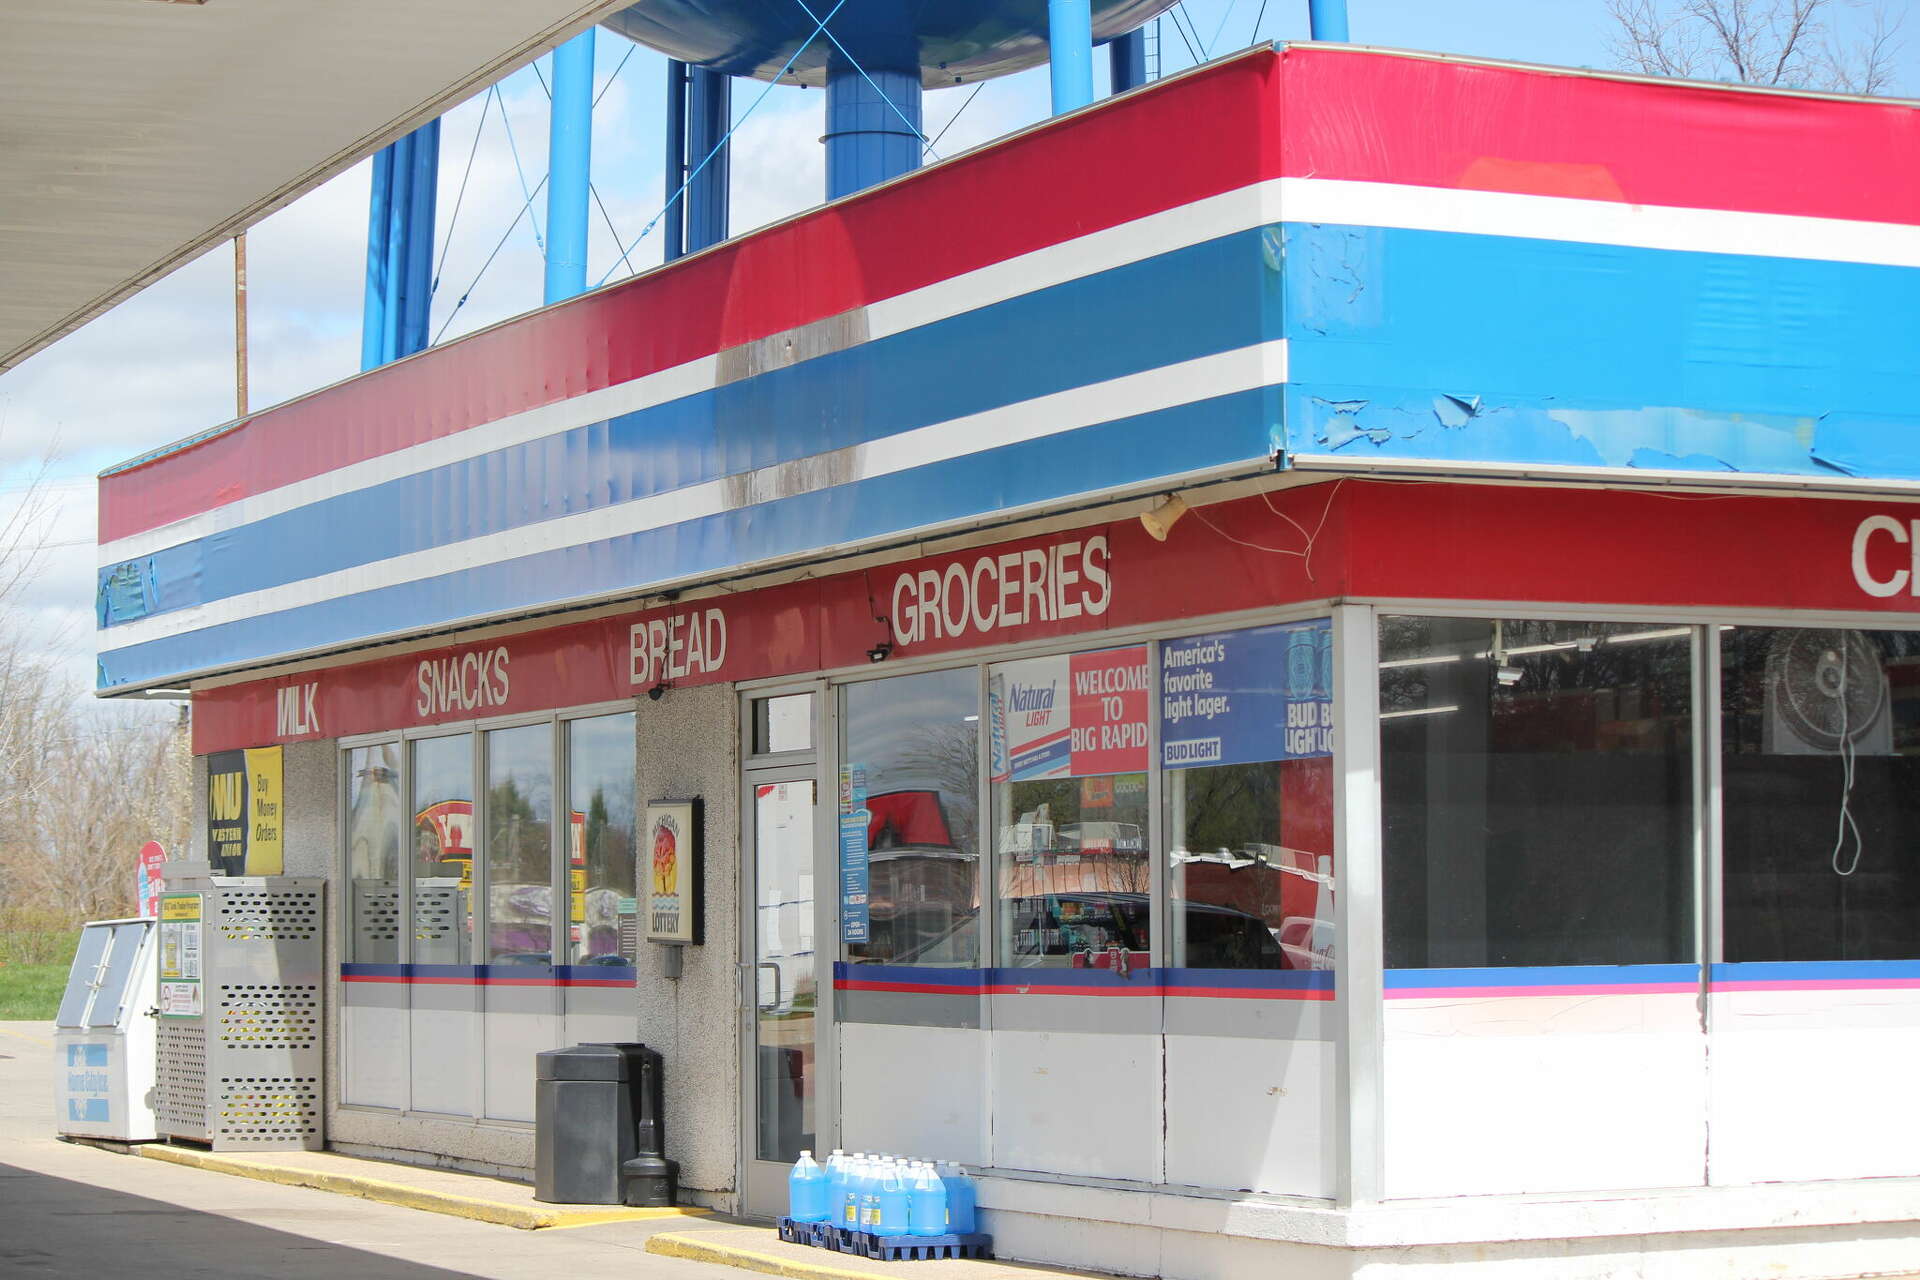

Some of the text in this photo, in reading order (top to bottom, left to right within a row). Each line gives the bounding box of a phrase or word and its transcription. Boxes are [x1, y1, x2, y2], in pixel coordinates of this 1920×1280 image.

[892, 536, 1112, 646] GROCERIES
[630, 608, 727, 685] BREAD
[1163, 640, 1225, 669] America's
[417, 646, 510, 718] SNACKS
[1075, 664, 1151, 696] WELCOME
[1164, 669, 1214, 695] favorite
[276, 681, 321, 738] MILK
[1009, 680, 1057, 713] Natural
[1101, 696, 1124, 722] TO
[1164, 694, 1231, 724] light lager.
[1026, 710, 1052, 728] LIGHT
[1287, 702, 1318, 728] BUD
[1071, 722, 1148, 753] BIG RAPID
[1166, 740, 1219, 761] BUD LIGHT
[1284, 728, 1318, 755] LIGH
[257, 773, 269, 796] Buy
[256, 798, 278, 820] Money
[255, 823, 278, 842] Orders
[652, 911, 680, 933] LOTTERY
